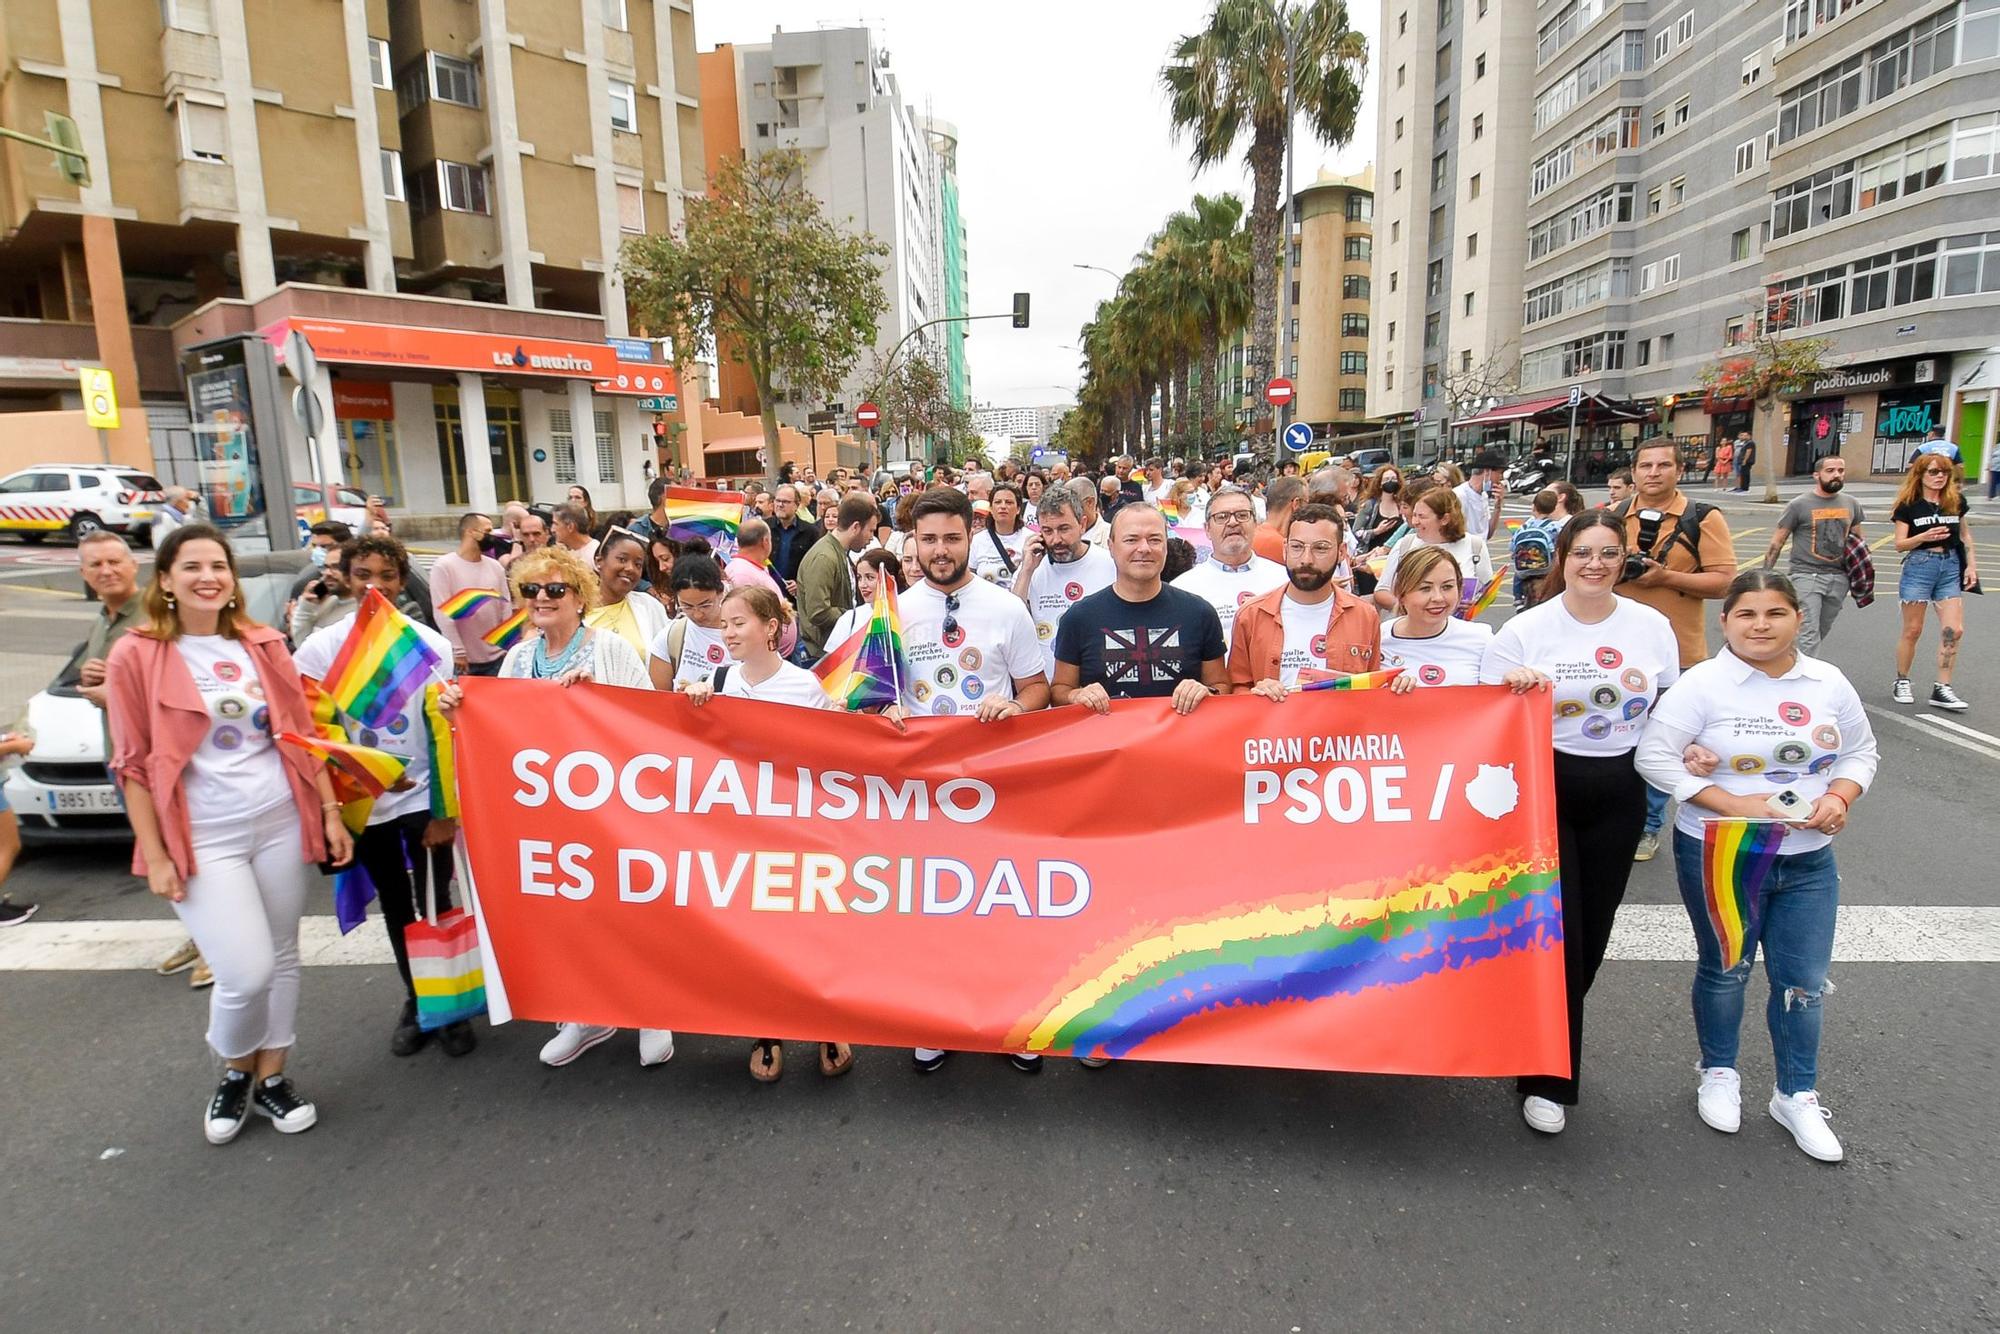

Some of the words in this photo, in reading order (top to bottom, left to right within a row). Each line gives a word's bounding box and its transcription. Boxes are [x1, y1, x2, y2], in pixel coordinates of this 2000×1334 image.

[1244, 737, 1302, 765] GRAN
[1308, 734, 1405, 763] CANARIA
[512, 748, 996, 824] SOCIALISMO
[1243, 765, 1412, 824] PSOE
[518, 839, 595, 901] ES
[617, 848, 1092, 919] DIVERSIDAD
